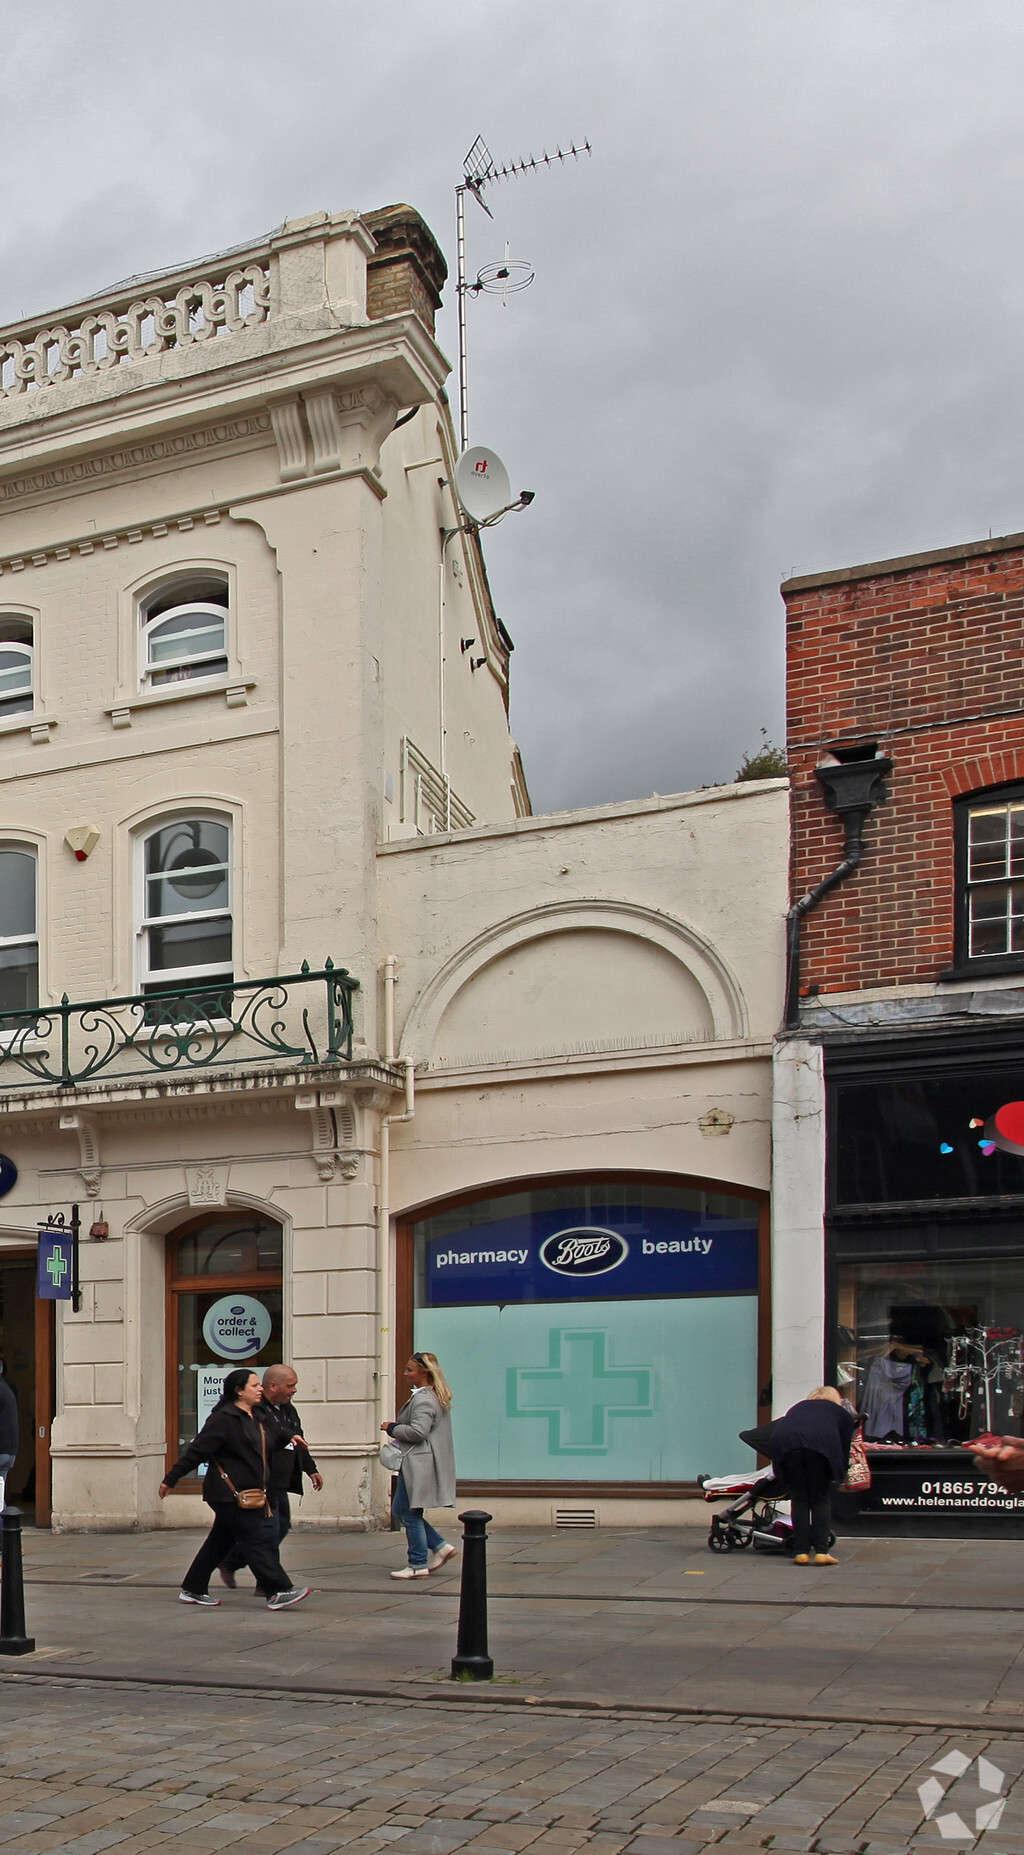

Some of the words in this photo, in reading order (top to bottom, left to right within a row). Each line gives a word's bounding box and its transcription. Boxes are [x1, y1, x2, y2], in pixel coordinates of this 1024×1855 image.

[436, 1248, 528, 1268] pharmacy
[551, 1237, 611, 1265] Boots
[642, 1236, 713, 1255] beauty
[217, 1316, 248, 1326] order
[249, 1316, 257, 1326] &
[218, 1326, 255, 1336] collect
[203, 1387, 221, 1396] just
[921, 1481, 974, 1494] 01865
